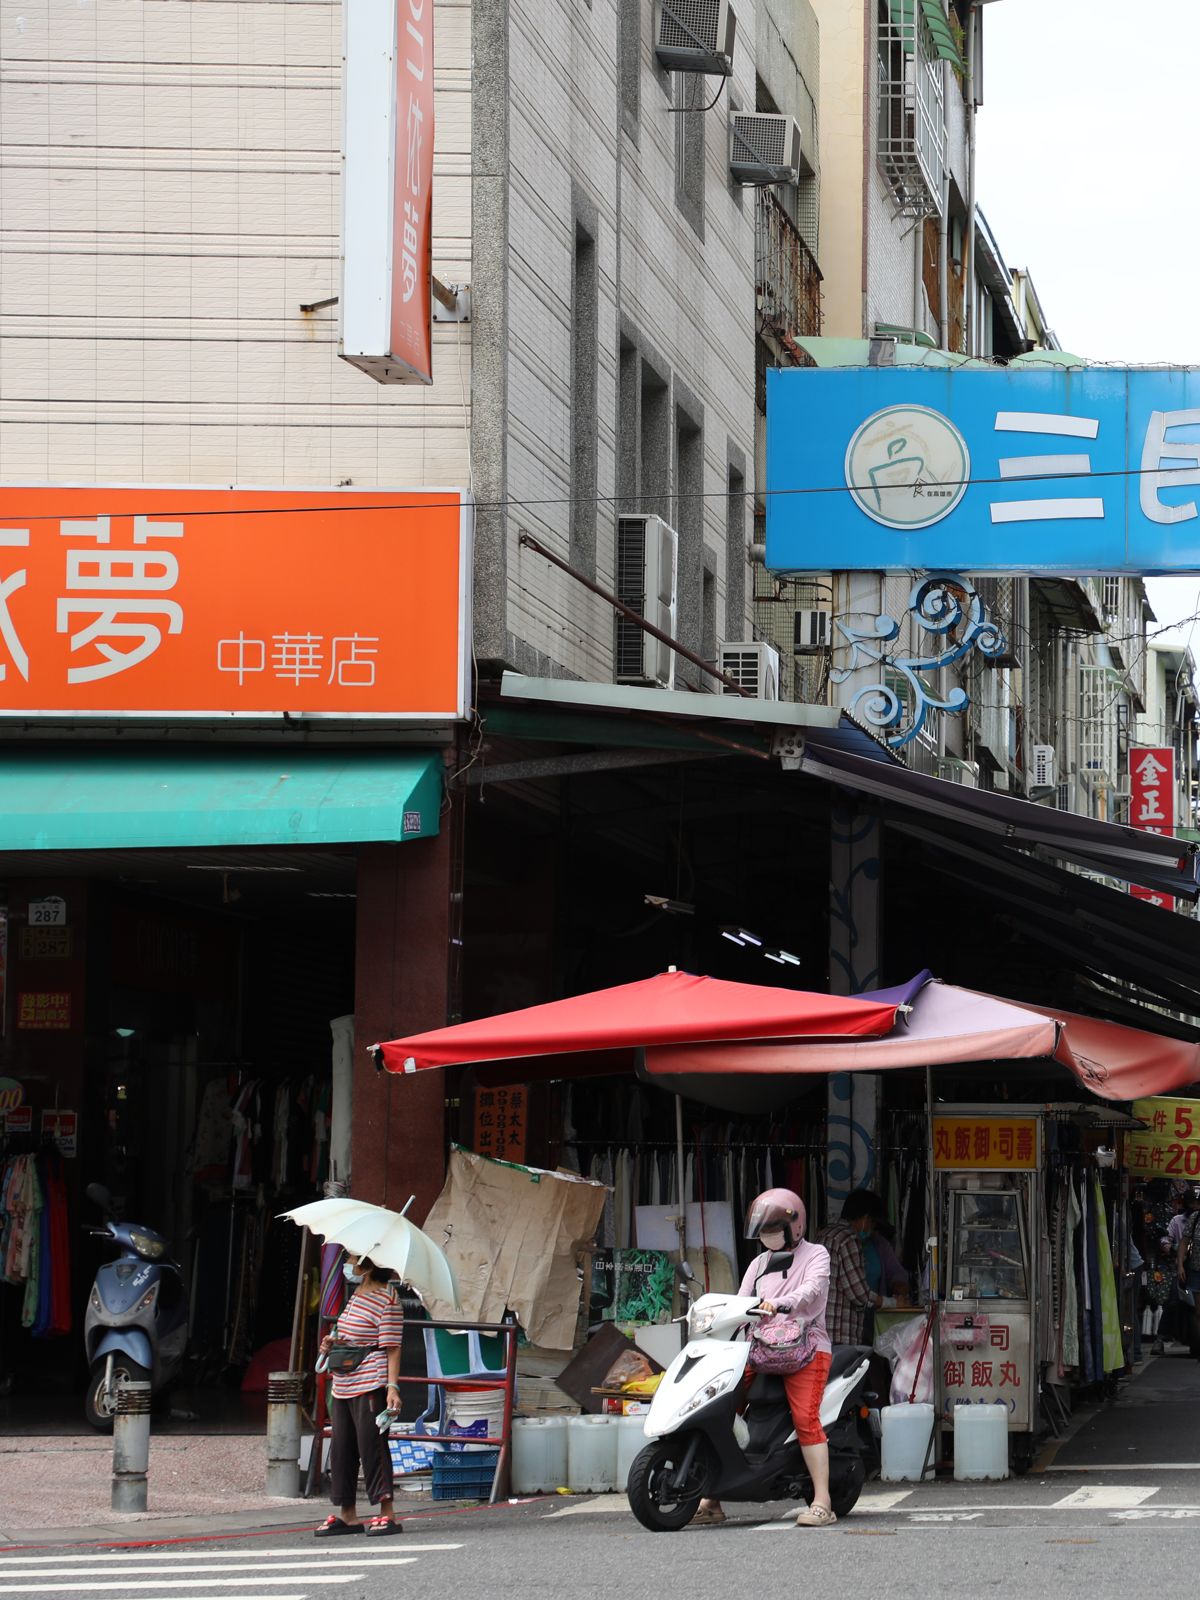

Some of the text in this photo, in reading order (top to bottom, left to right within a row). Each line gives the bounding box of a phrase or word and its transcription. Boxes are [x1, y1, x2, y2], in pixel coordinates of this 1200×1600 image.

[0, 513, 184, 685] 夢
[217, 630, 380, 687] 中華店
[34, 910, 60, 922] 287
[37, 940, 68, 954] 287
[944, 1360, 1021, 1388] 御飯丸
